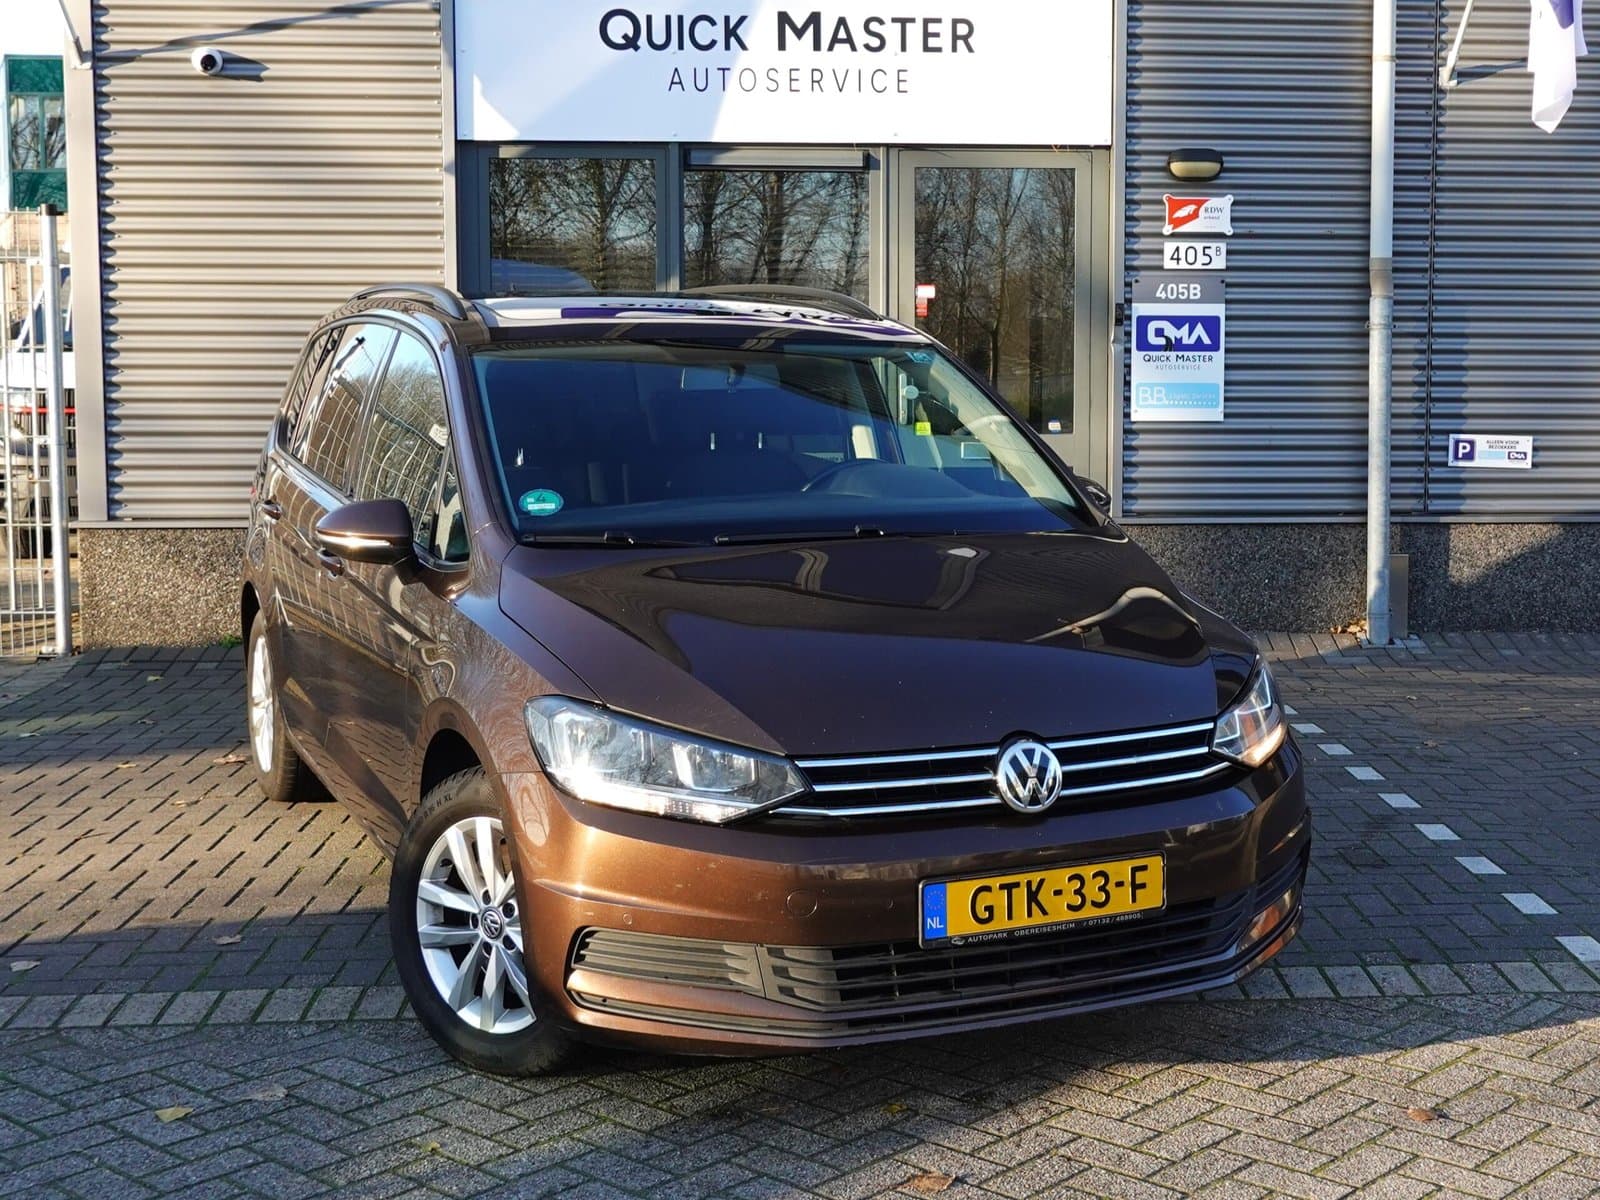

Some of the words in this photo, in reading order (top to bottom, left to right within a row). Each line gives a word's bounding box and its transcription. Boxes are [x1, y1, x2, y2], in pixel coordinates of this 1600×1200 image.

[600, 8, 749, 52] QUICK
[777, 10, 975, 53] MASTER
[668, 67, 909, 93] AUTOSERVICE
[1155, 283, 1201, 299] 405B
[1176, 354, 1213, 362] MASTER
[1458, 442, 1471, 458] P
[970, 864, 1149, 925] GTK-33-F
[927, 917, 944, 929] NL
[967, 932, 1008, 943] AUTOPARK
[1014, 922, 1075, 937] OBEREISESHEIM
